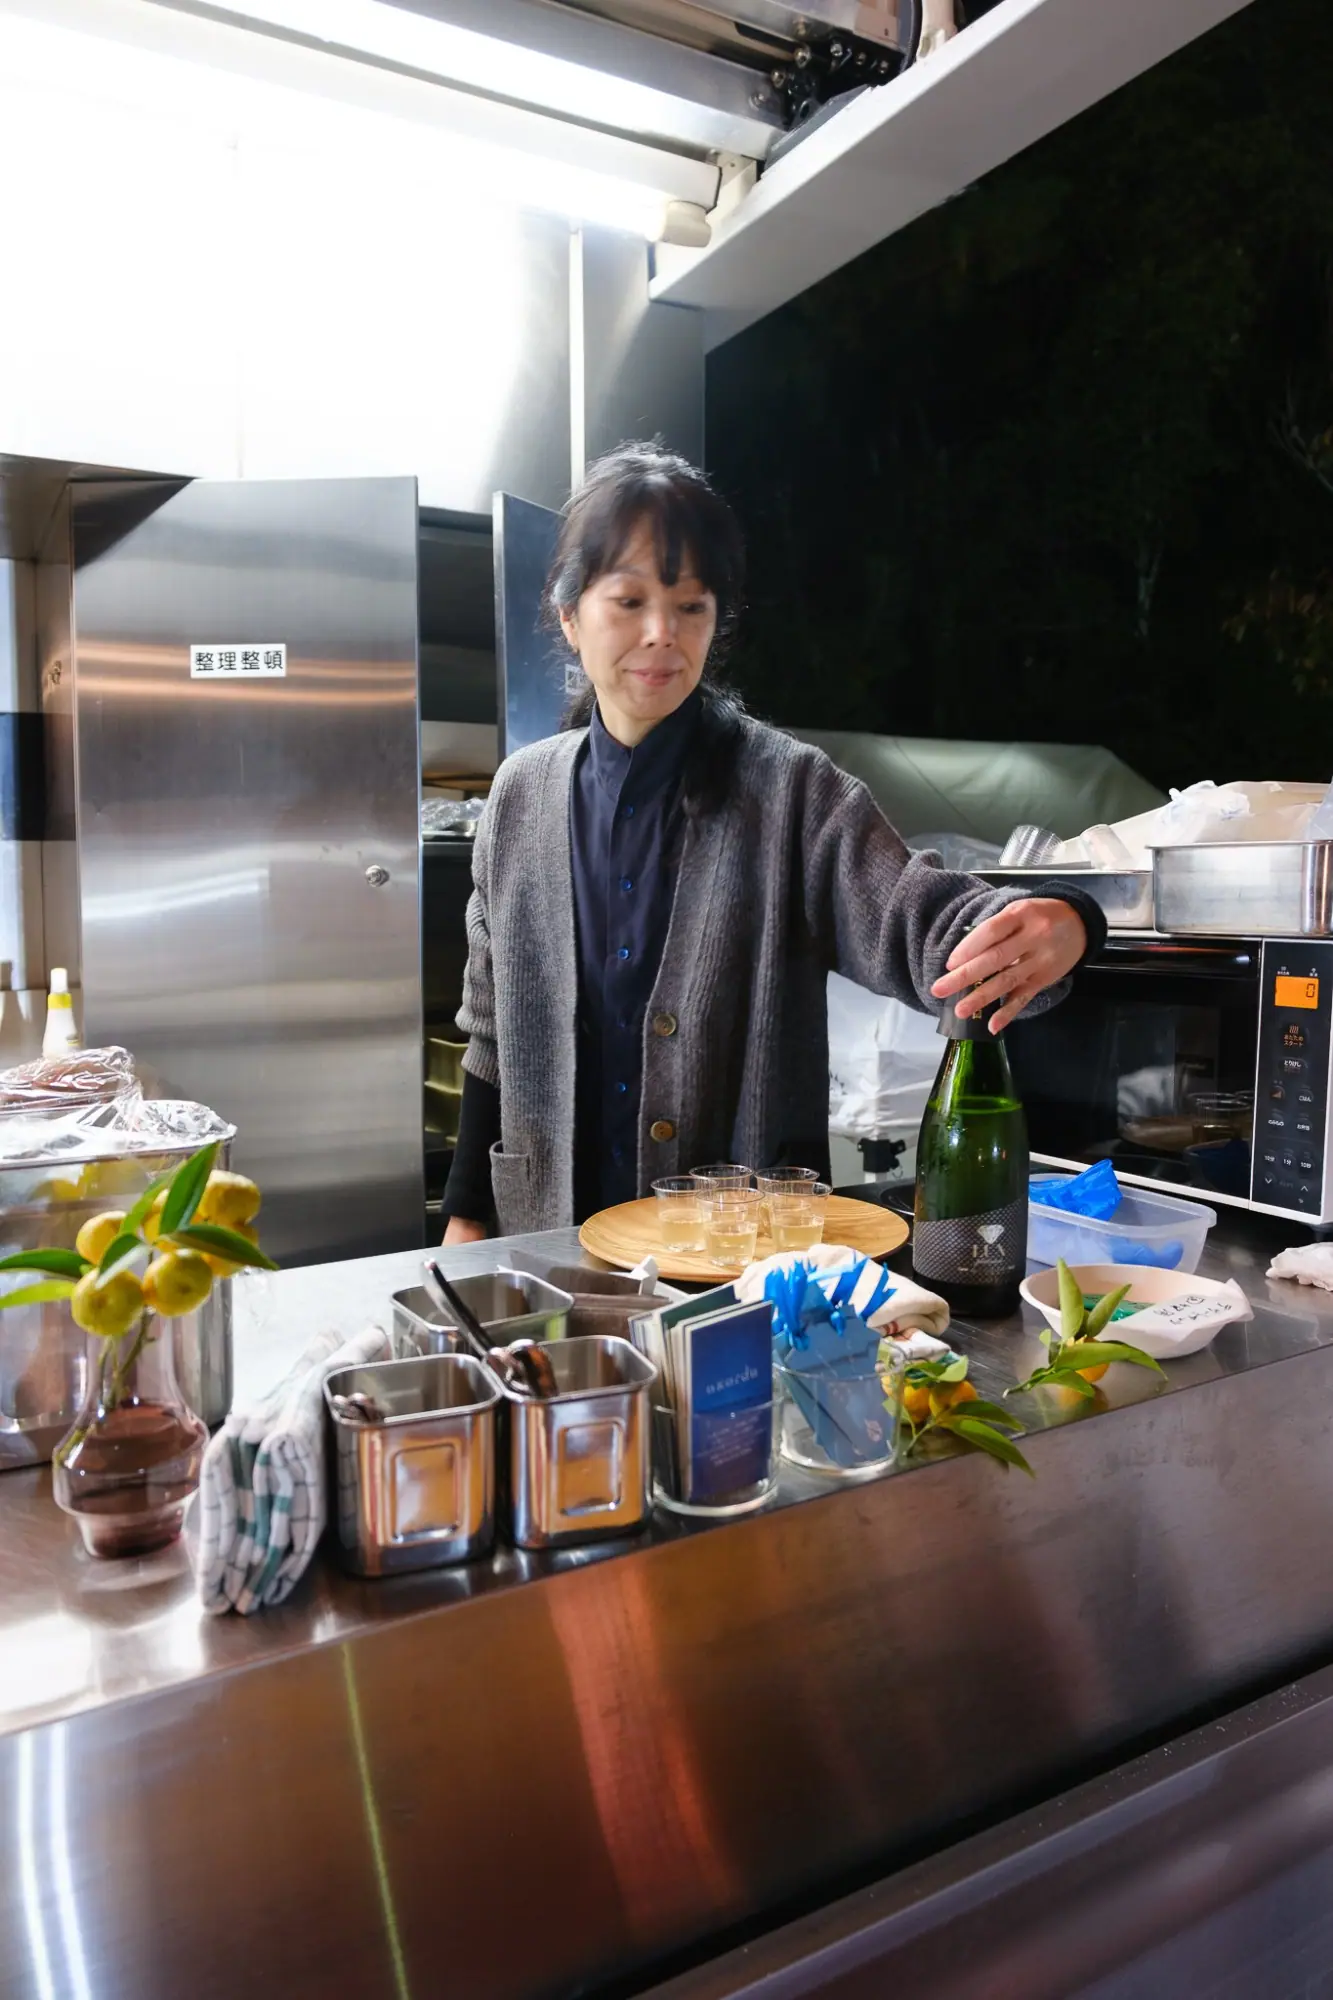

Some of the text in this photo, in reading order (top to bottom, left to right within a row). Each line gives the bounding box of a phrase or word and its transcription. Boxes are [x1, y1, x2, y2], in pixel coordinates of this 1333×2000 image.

[195, 650, 284, 672] 整理整頓
[1306, 983, 1316, 998] 0
